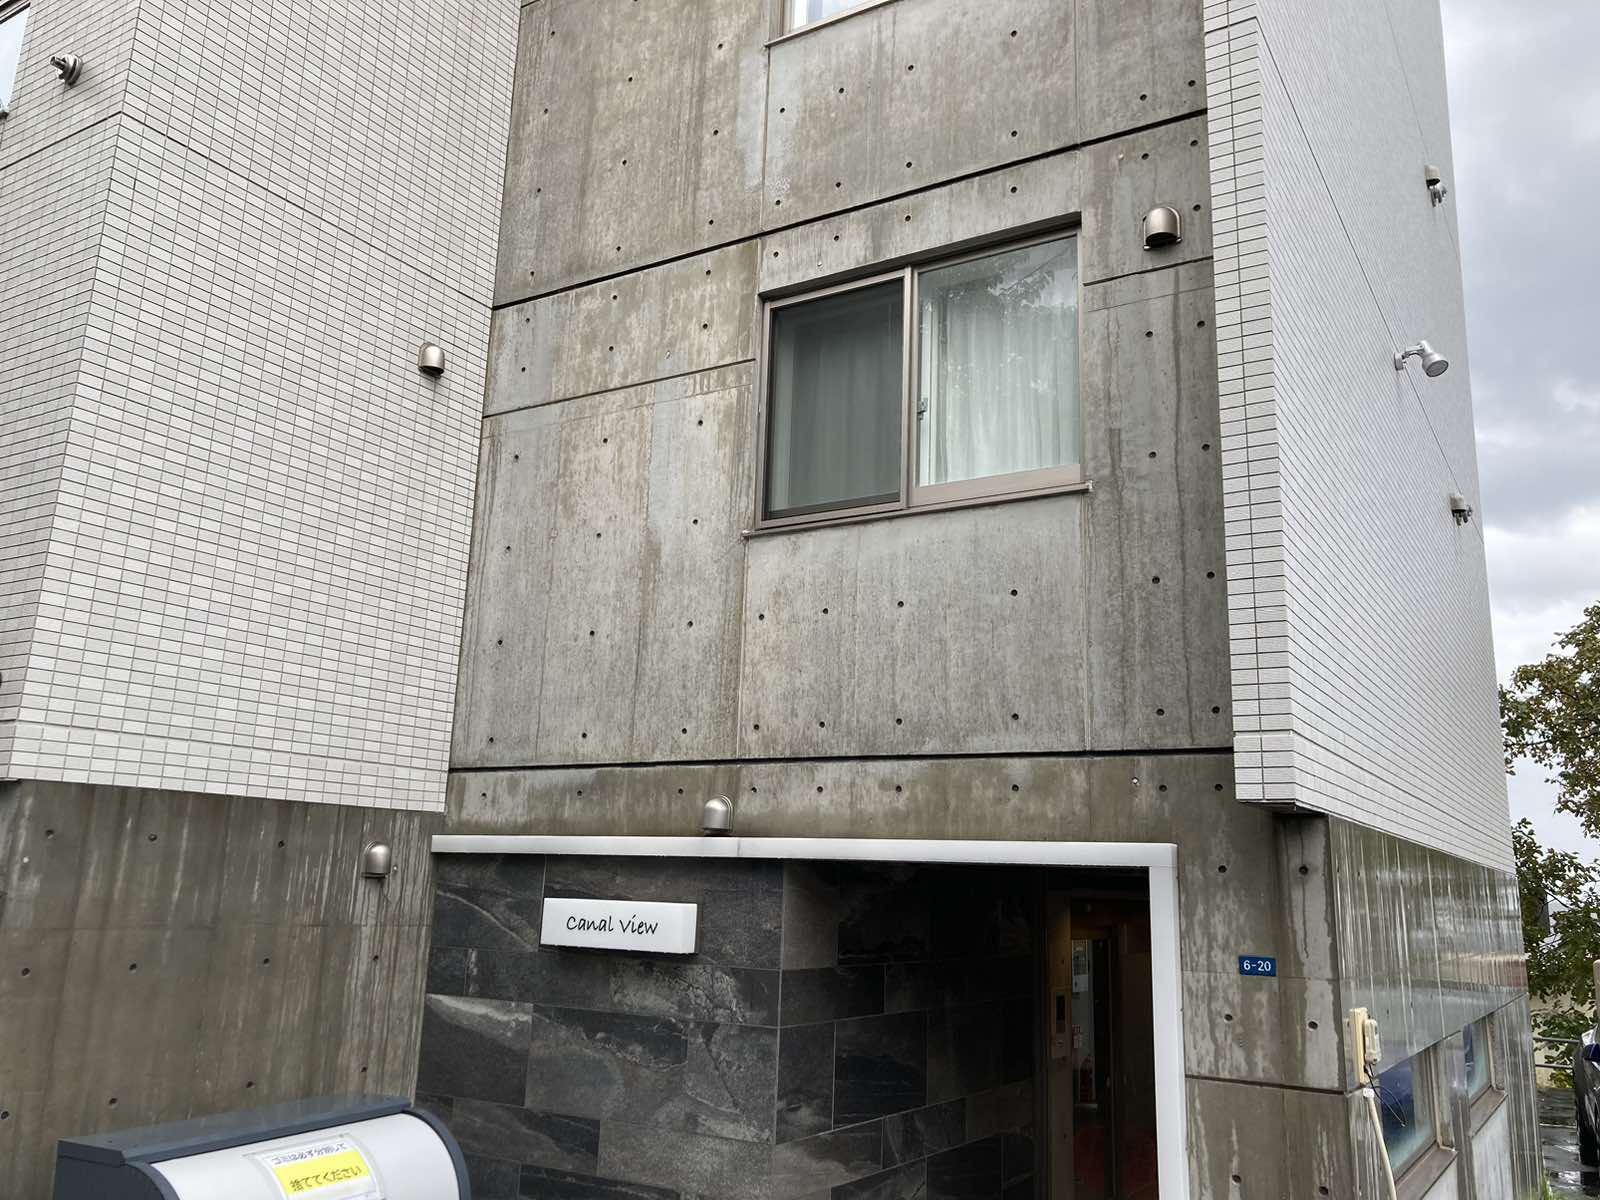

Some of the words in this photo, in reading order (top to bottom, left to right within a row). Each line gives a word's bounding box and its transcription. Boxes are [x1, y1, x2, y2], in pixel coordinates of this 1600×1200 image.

[1243, 959, 1272, 972] 6-20
[289, 1165, 362, 1192] 捨ててください
